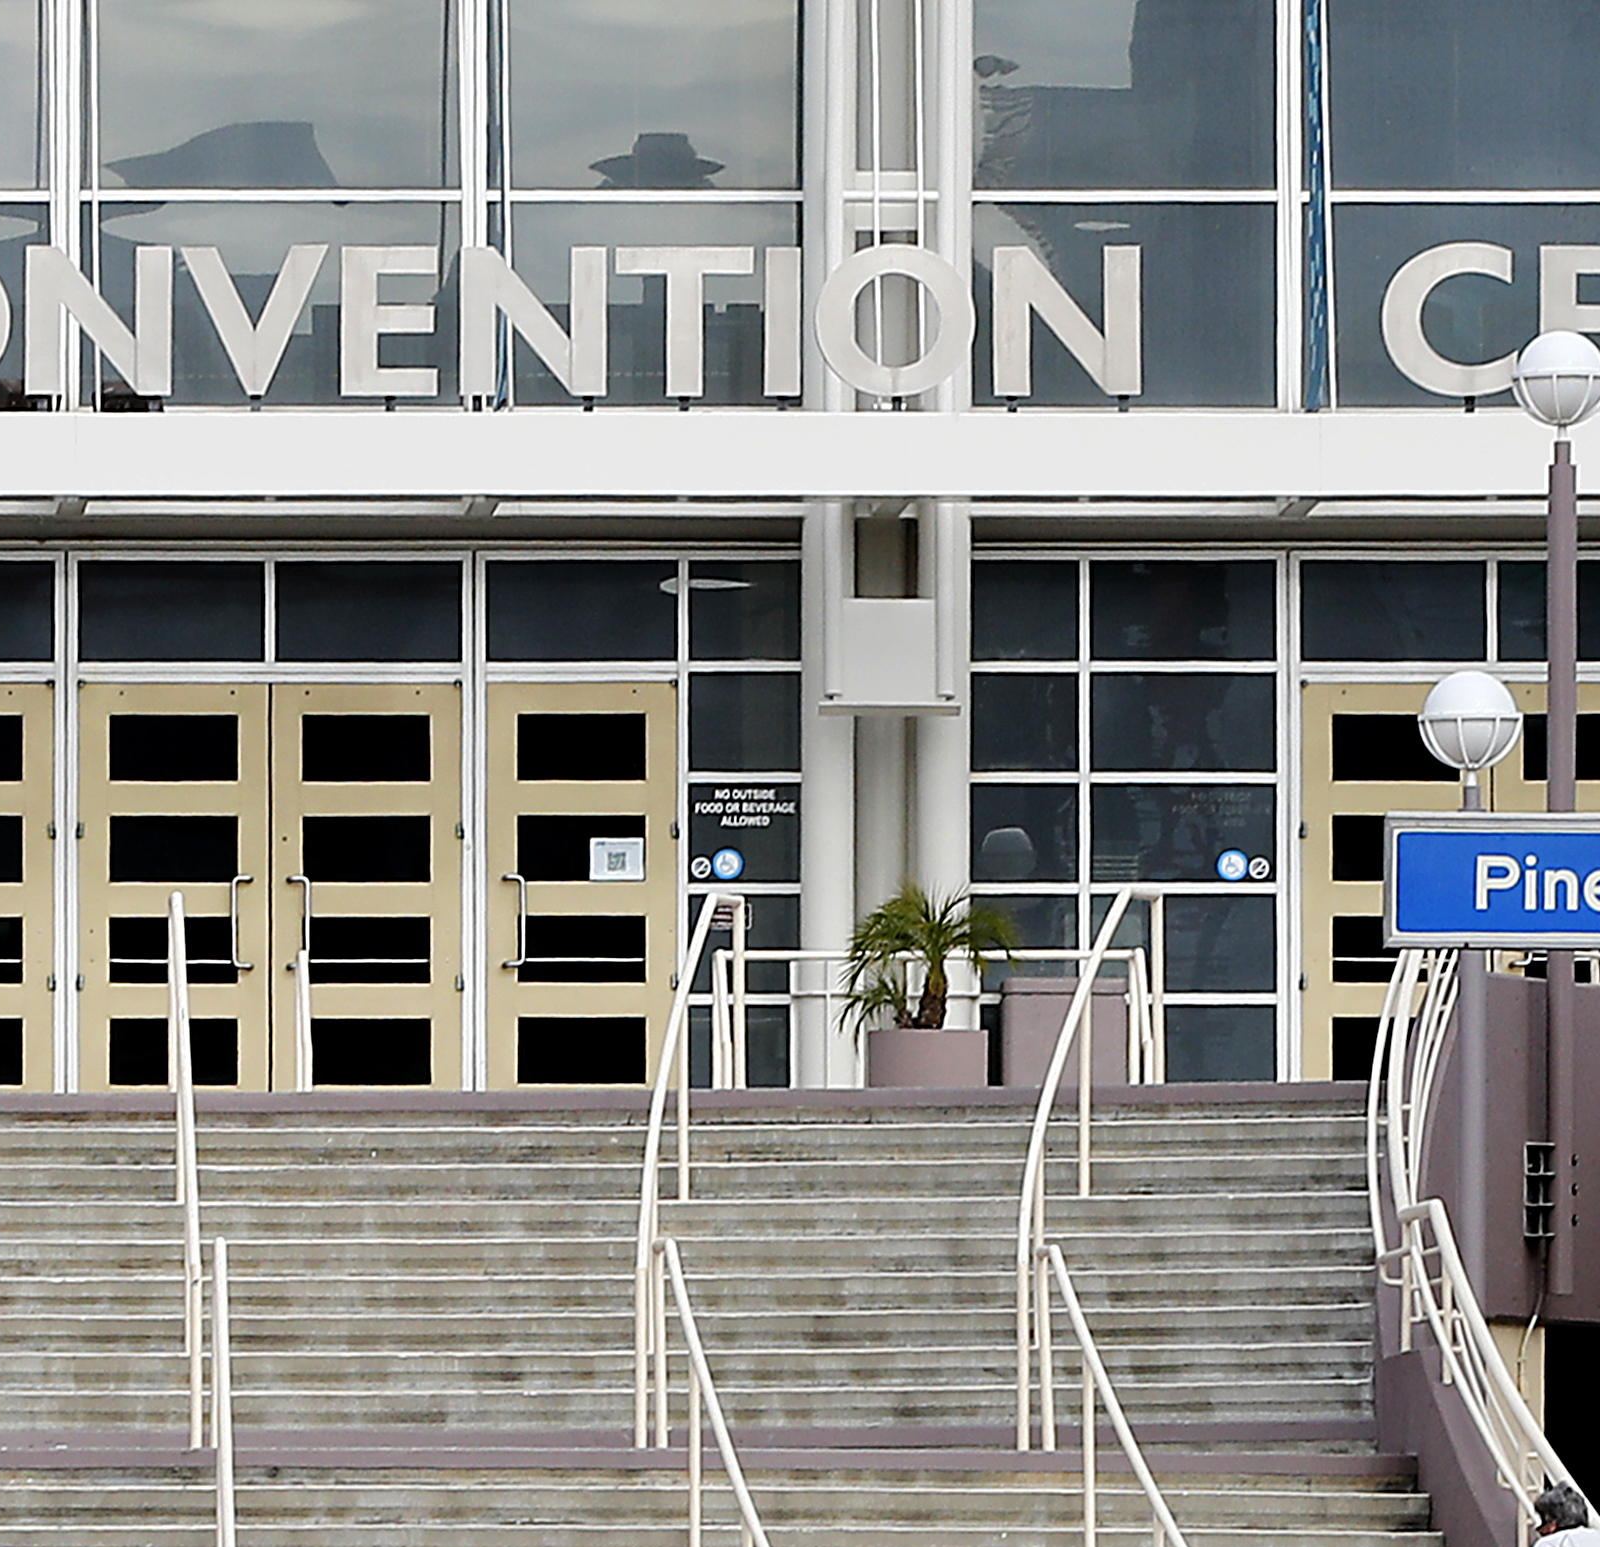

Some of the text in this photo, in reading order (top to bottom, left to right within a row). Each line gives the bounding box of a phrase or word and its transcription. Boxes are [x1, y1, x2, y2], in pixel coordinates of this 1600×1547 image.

[713, 788, 776, 800] NO OUTSIDE
[694, 802, 796, 814] FOOD OR BEVERAGE
[719, 815, 771, 827] ALLOWED
